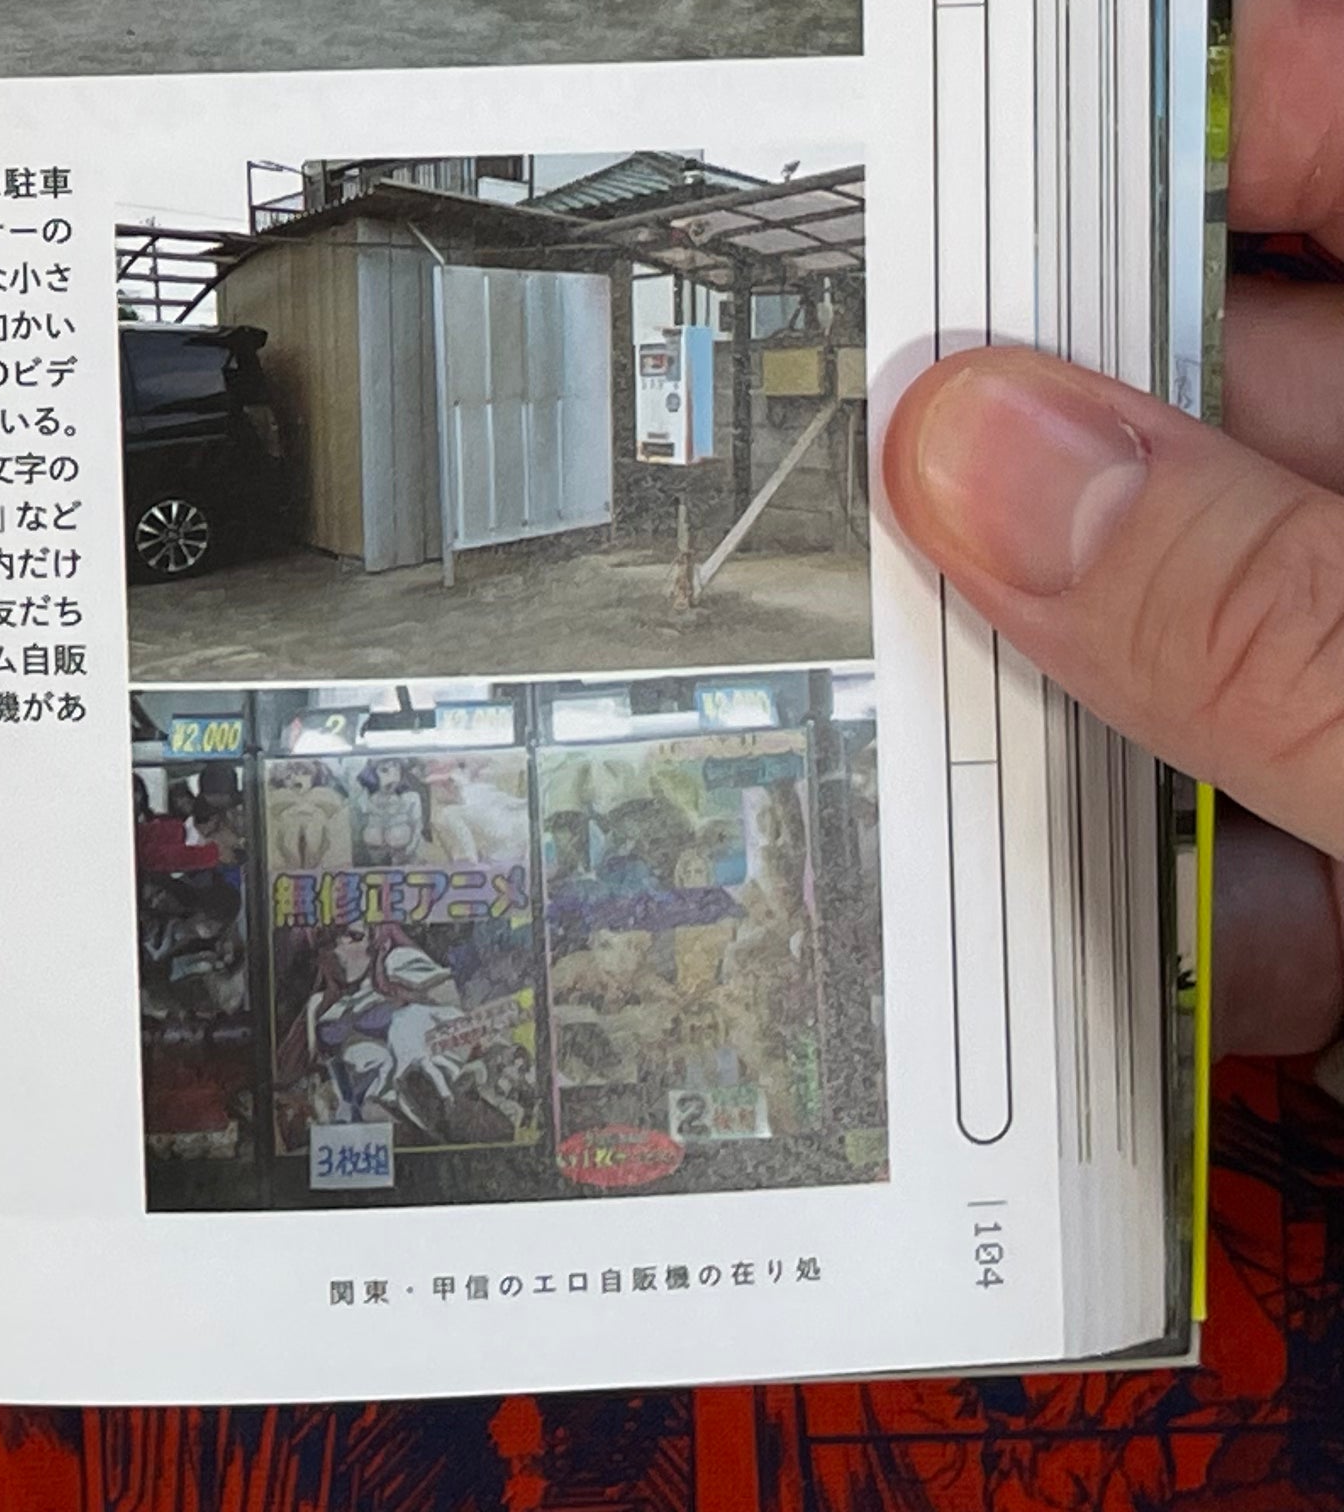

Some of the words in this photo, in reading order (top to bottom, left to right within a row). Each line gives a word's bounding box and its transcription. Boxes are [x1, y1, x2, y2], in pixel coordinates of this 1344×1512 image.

[317, 1144, 390, 1178] 3枚組
[974, 1221, 1004, 1289] 104
[330, 1256, 822, 1306] 関東・甲信のエロ自販機の在り処
